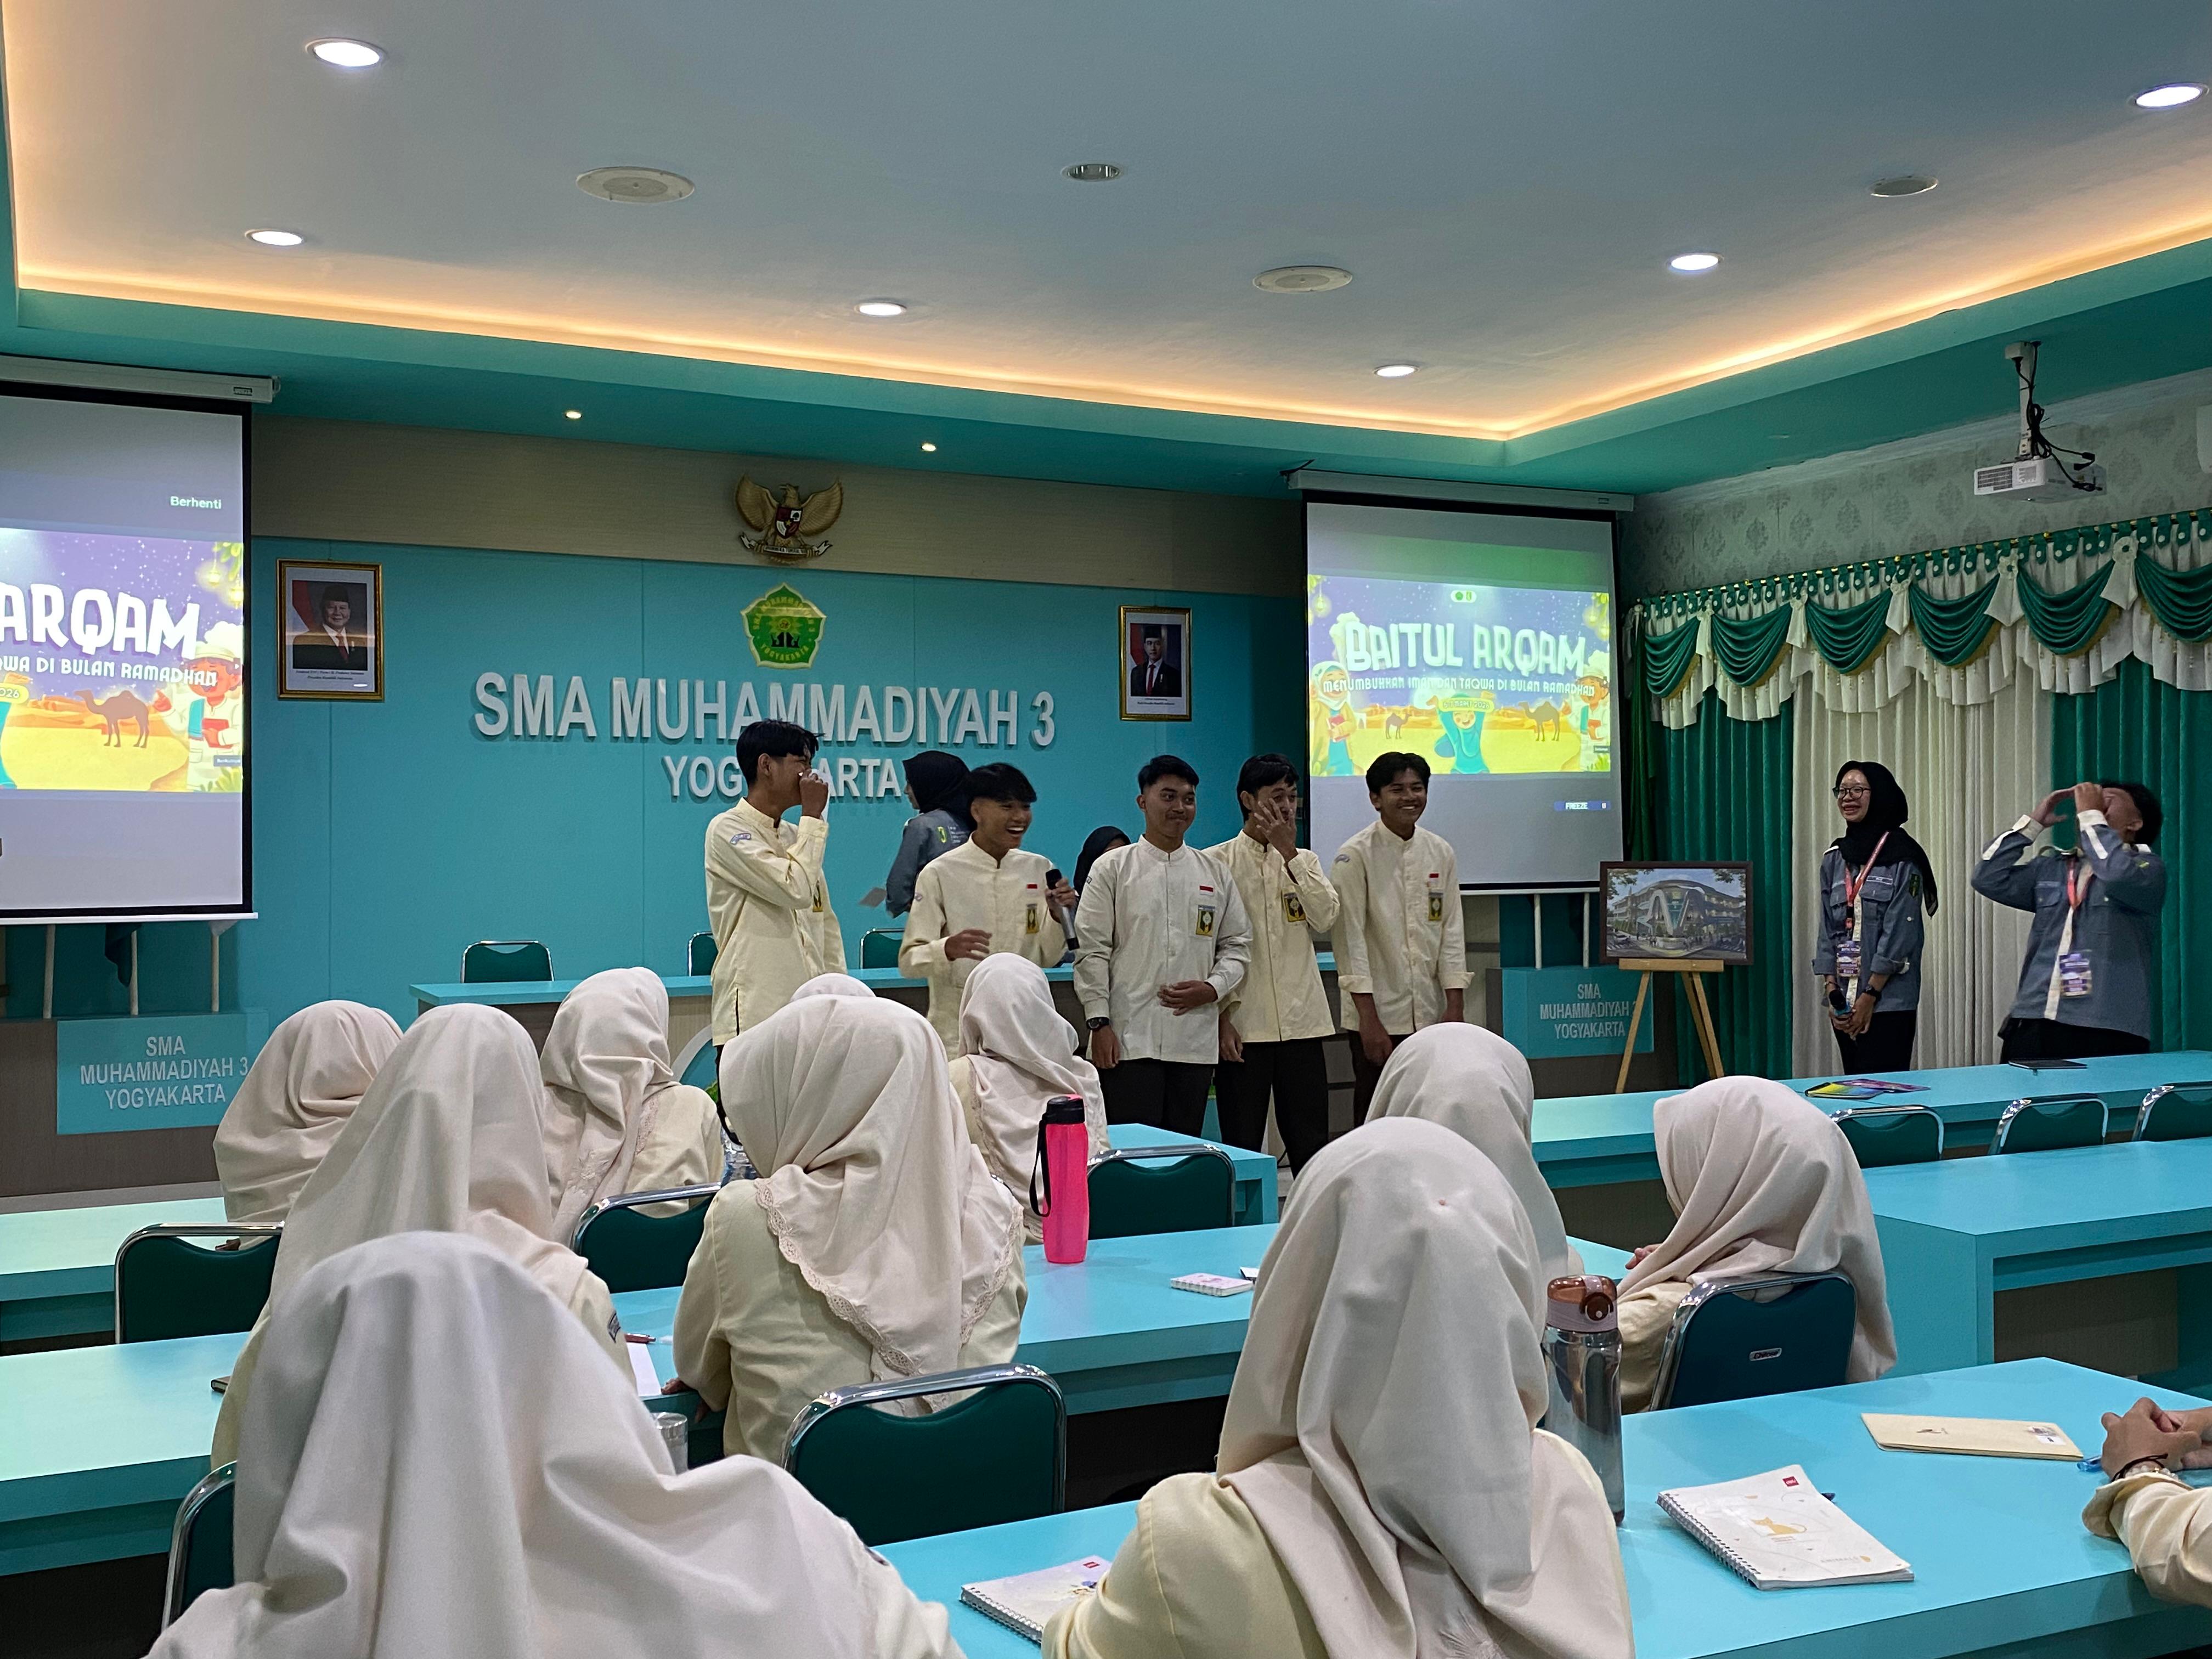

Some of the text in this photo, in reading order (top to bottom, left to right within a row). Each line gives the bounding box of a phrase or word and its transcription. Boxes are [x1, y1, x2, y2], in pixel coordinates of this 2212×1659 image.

[170, 496, 222, 509] Berhenti
[0, 582, 200, 659] ARQAM
[1345, 622, 1586, 677] BAITUL ARQAM
[36, 657, 54, 674] DI
[61, 658, 115, 678] BULAN
[121, 663, 217, 687] RAMADHAN
[1323, 677, 1405, 692] MENUMBUHKAN
[1436, 677, 1457, 690] DAN
[1460, 678, 1494, 690] TAQWA
[1497, 679, 1508, 691] DI
[1510, 679, 1540, 692] BULAN
[1542, 684, 1595, 697] RAMADHAN
[475, 672, 1055, 746] SMA MUHAMMADIYAH 3
[663, 755, 901, 798] YOGARTA
[1565, 802, 1588, 810] FREEZE
[1577, 983, 1601, 1000] SMA
[1540, 1001, 1629, 1019] MUHAMMADIYAH
[1554, 1021, 1626, 1039] YOGYAKARTA
[146, 1036, 186, 1057] SMA
[80, 1057, 248, 1085] MUHAMMADIYAH 3
[105, 1084, 226, 1110] YOGYAKARTA
